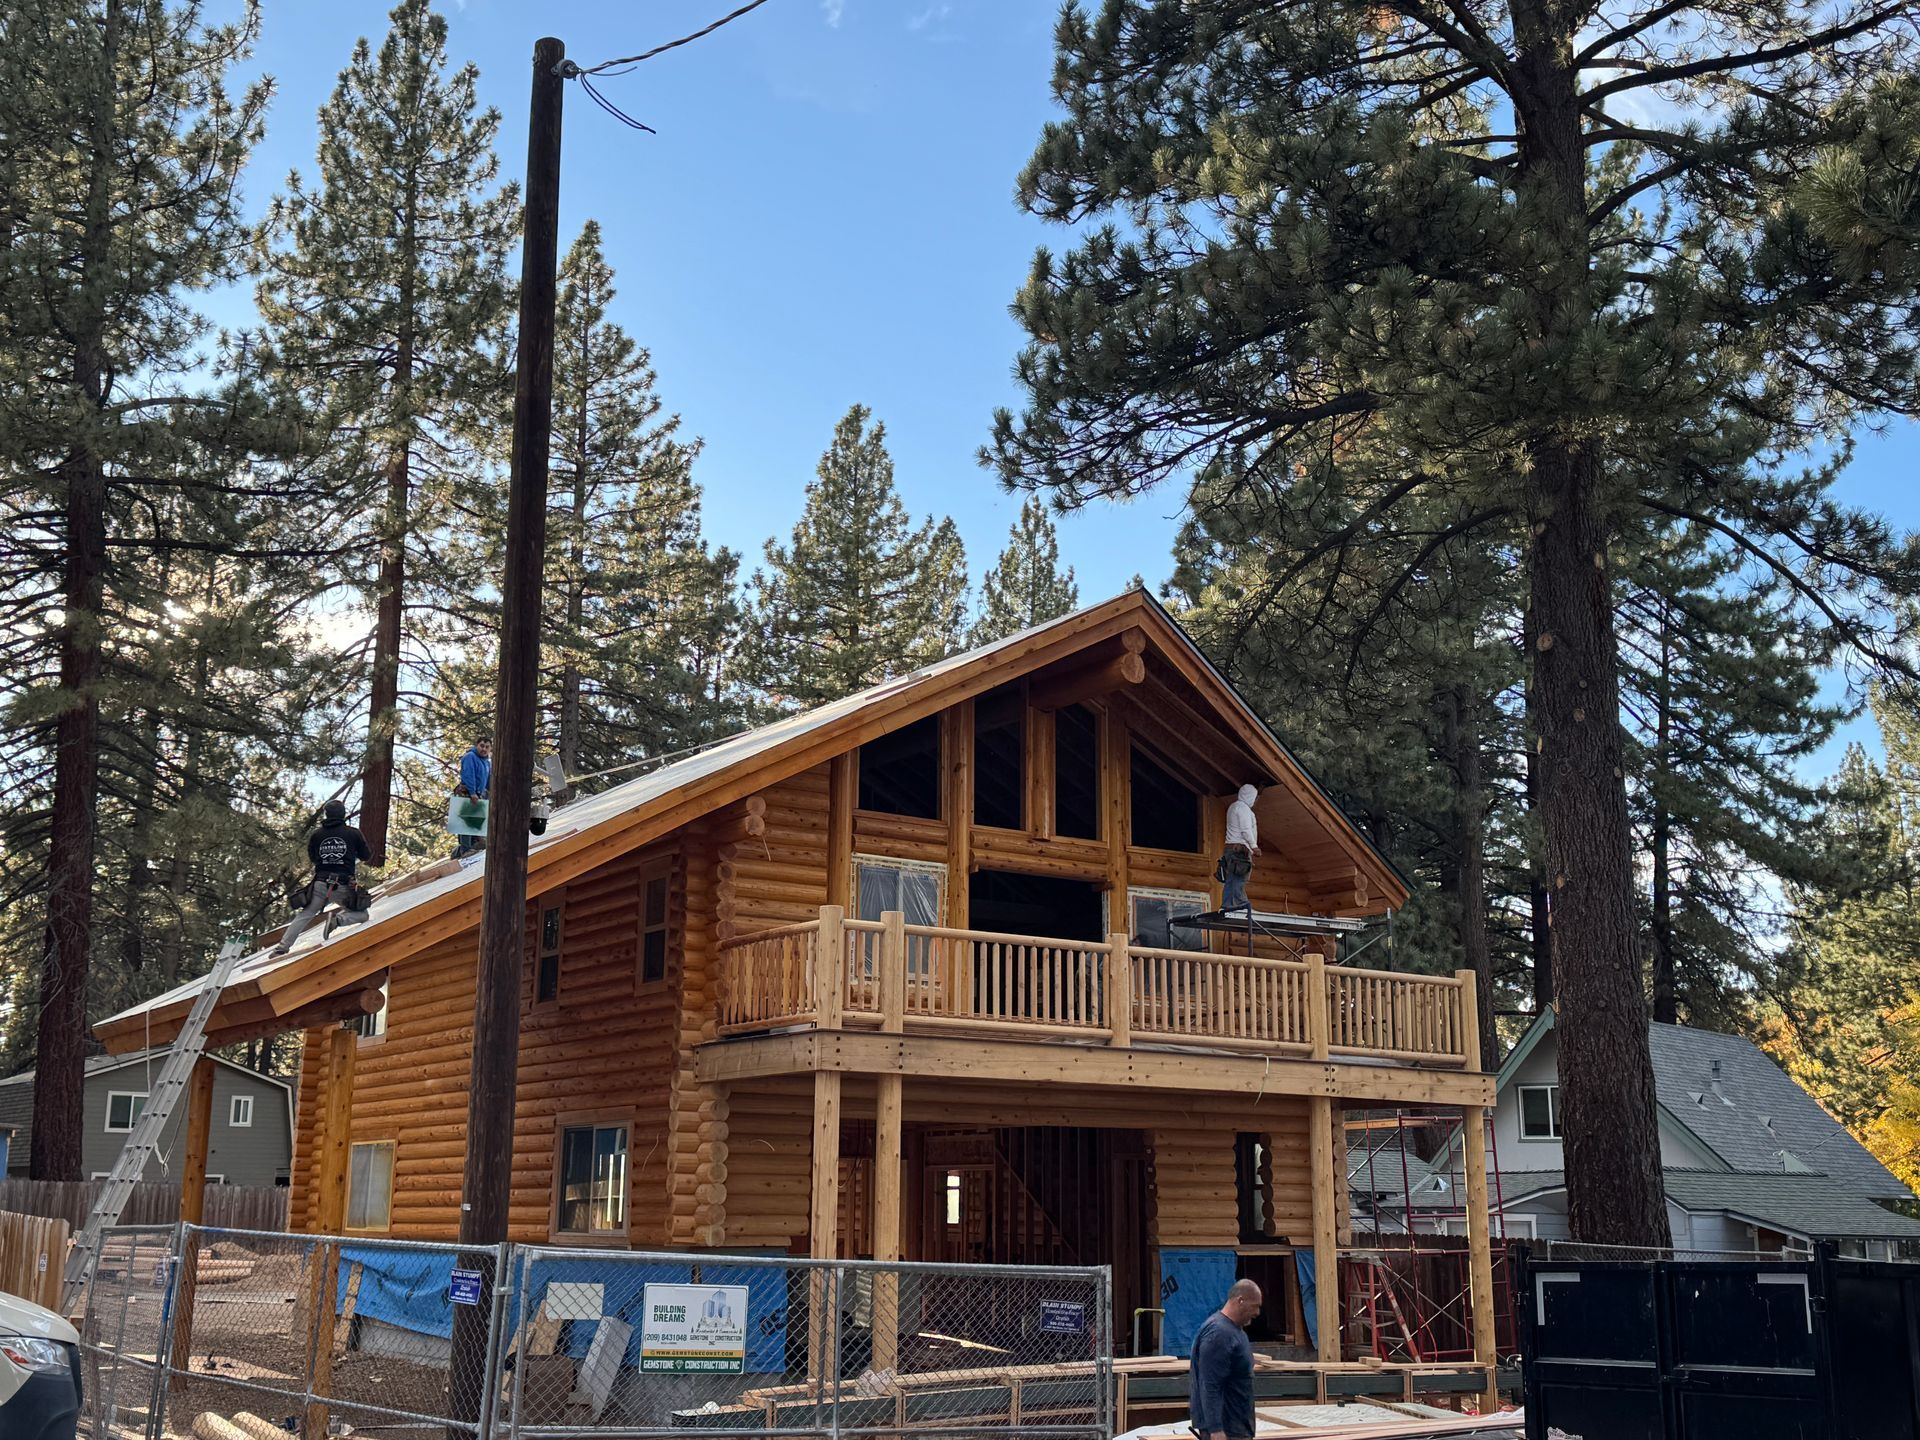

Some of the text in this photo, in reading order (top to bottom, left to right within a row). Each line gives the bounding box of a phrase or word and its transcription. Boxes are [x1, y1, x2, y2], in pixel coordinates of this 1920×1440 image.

[653, 1304, 686, 1313] BUILDING
[653, 1313, 685, 1322] DREAMS
[644, 1333, 660, 1342] (209)
[643, 1359, 740, 1370] GEMSTONE CONSTRUCTION INC
